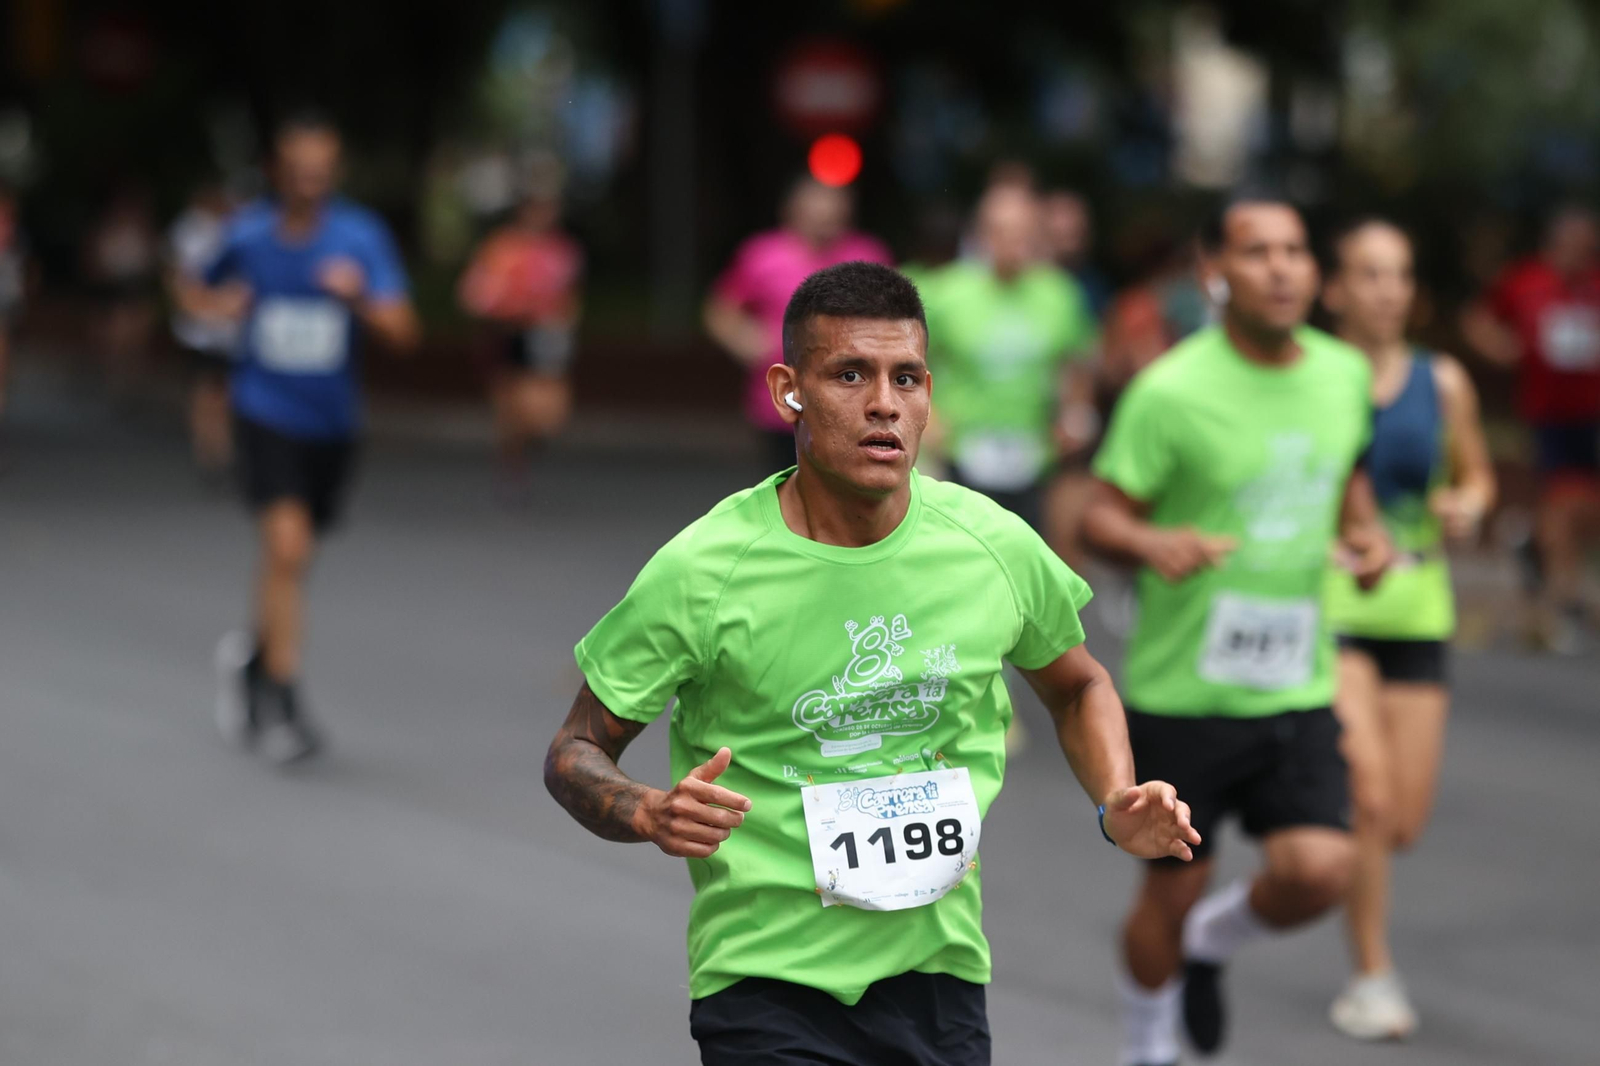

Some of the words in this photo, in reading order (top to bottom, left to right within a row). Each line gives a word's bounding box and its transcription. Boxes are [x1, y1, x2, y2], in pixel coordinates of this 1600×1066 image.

[861, 785, 926, 809] Carrera
[876, 798, 933, 818] Prensa
[830, 818, 964, 869] 1198
